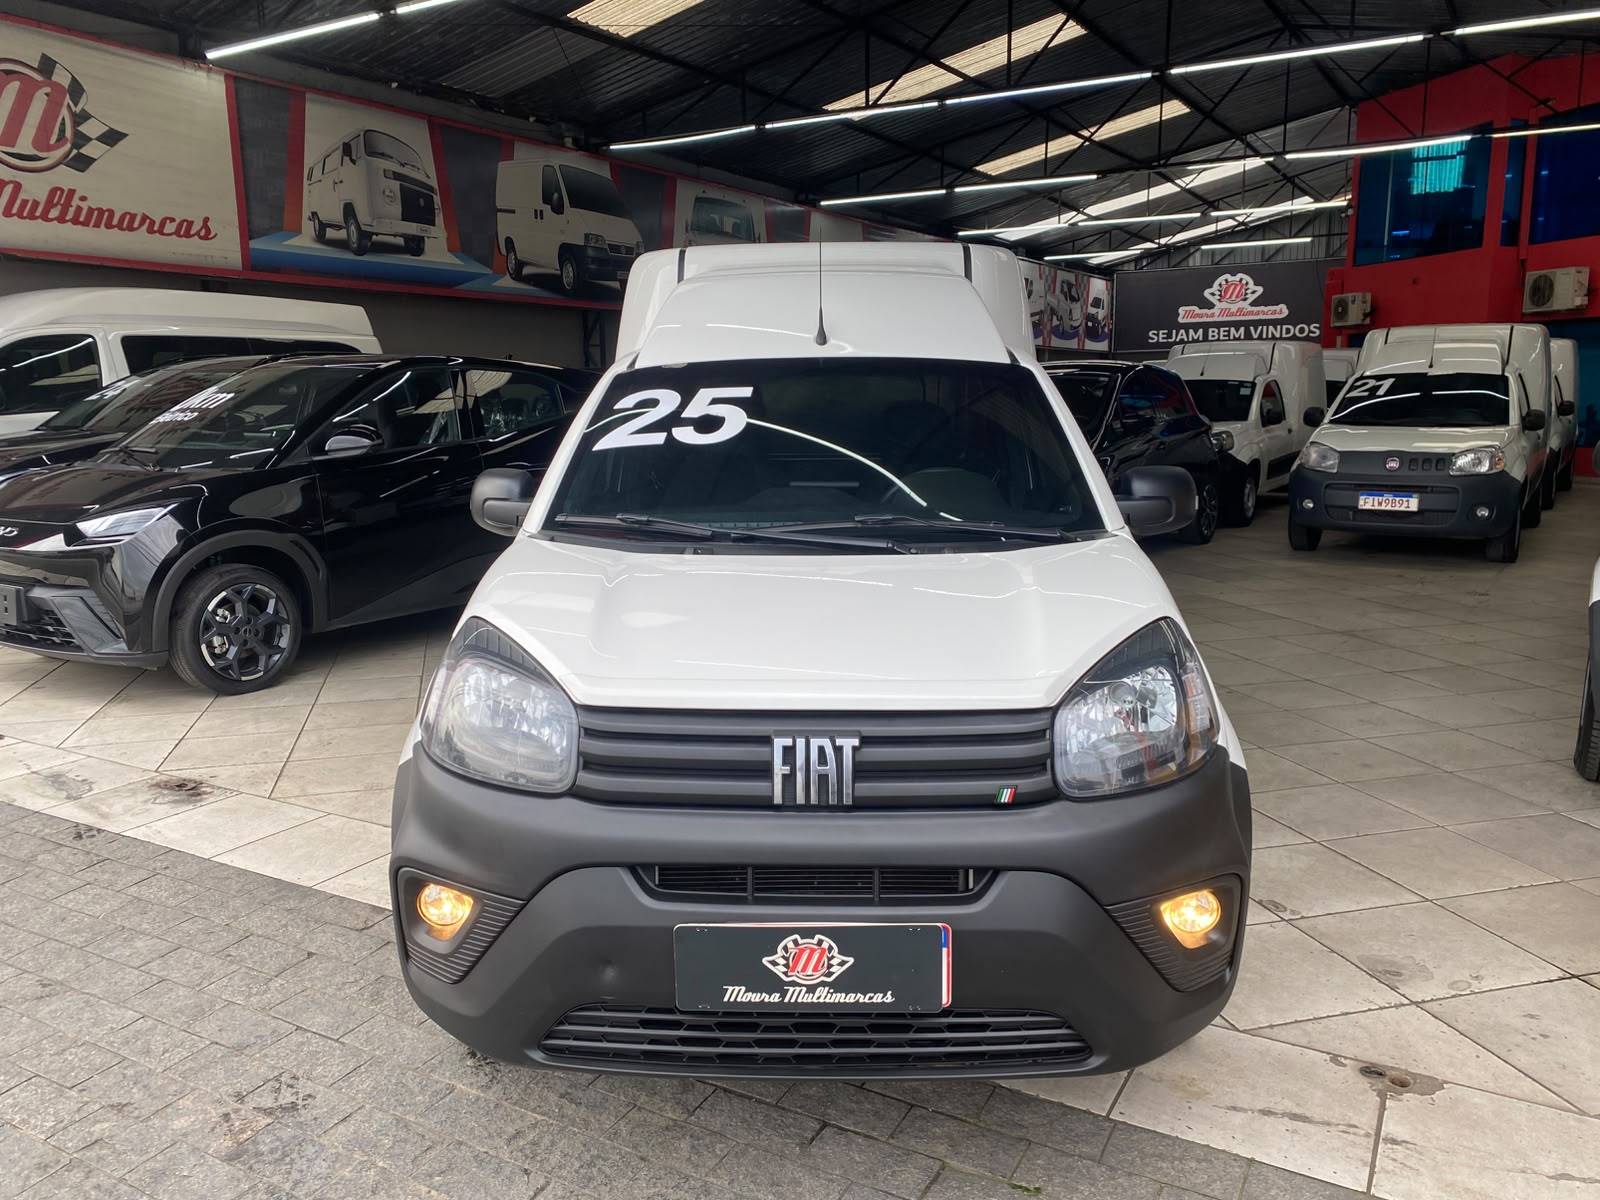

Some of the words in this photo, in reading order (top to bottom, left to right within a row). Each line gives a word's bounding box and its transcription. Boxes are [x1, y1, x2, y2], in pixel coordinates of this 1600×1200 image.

[1181, 309, 1216, 320] Moura
[1217, 306, 1285, 319] Multimarcas
[1148, 329, 1204, 343] SEJAM
[1208, 326, 1246, 341] BEM
[1249, 323, 1321, 339] VINDOS
[1345, 377, 1396, 398] 21
[592, 386, 754, 451] 25
[1363, 497, 1411, 509] FIW9B91
[773, 738, 859, 805] FIAT
[722, 986, 782, 1003] Moura
[783, 986, 896, 1003] Multimarcas
